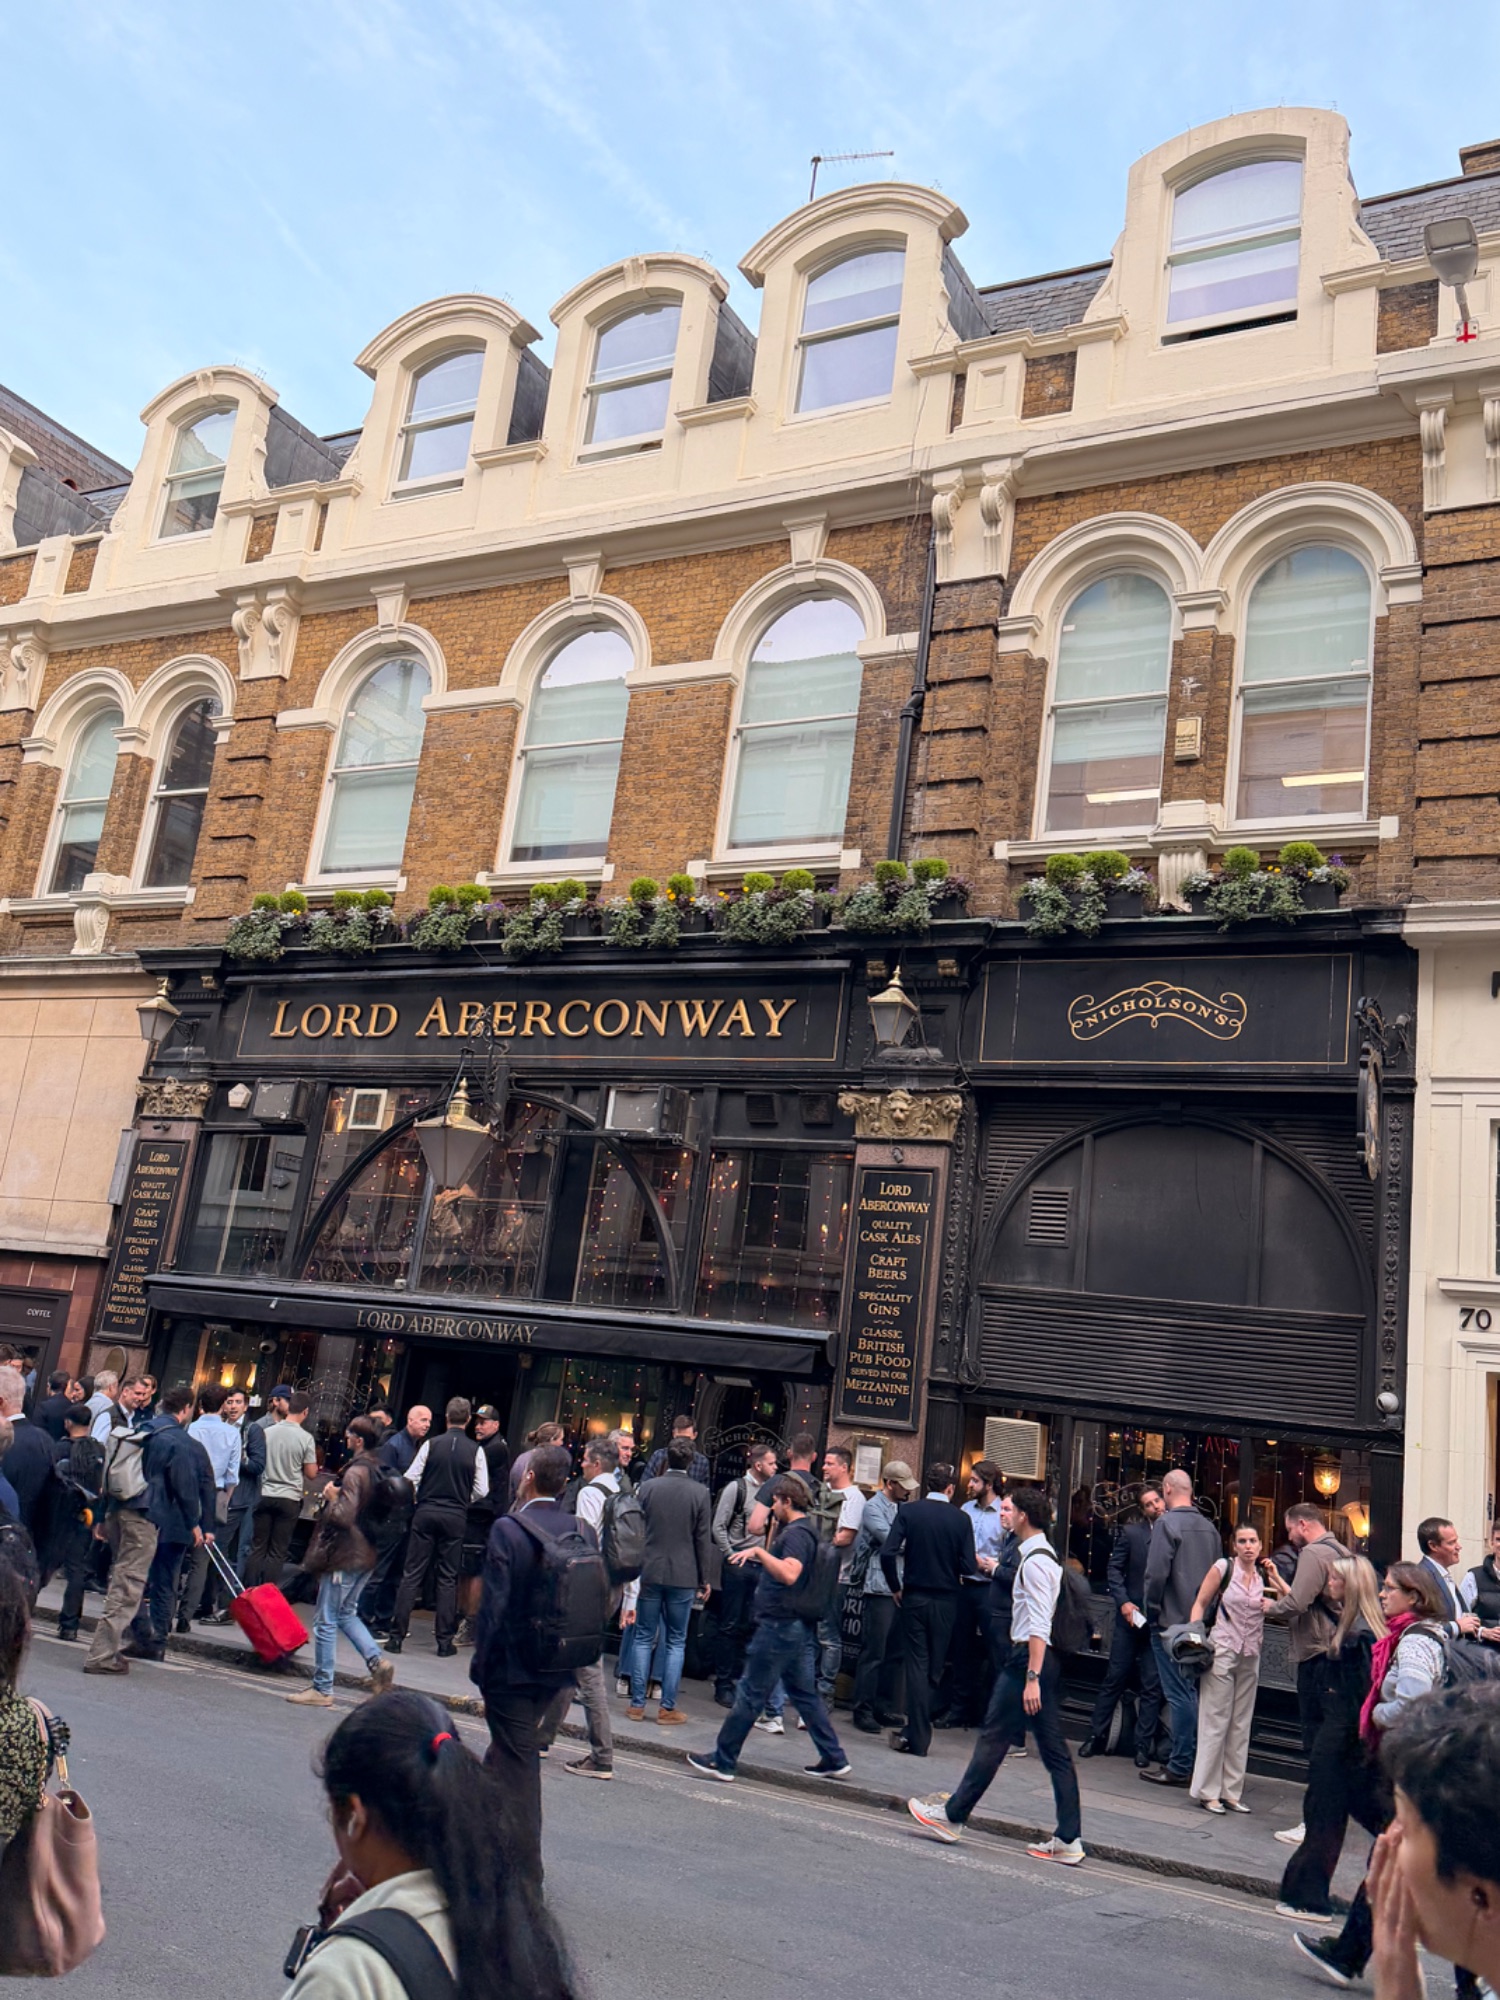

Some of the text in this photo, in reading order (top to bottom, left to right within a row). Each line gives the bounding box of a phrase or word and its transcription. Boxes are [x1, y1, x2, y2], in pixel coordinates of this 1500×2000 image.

[270, 996, 797, 1037] LORD ABERCONWAY
[1085, 997, 1229, 1027] NICHOLSON'S
[148, 1151, 170, 1162] LORD
[134, 1164, 180, 1176] ABERCONWAY
[141, 1181, 167, 1189] QUALITY
[880, 1182, 912, 1196] LORD
[132, 1190, 171, 1200] CASK ALES
[859, 1198, 931, 1213] ABERCONWAY
[135, 1208, 160, 1217] CRAFT
[132, 1218, 158, 1228] BEERS
[871, 1220, 912, 1231] QUALITY
[124, 1237, 159, 1246] SPECIALITY
[860, 1230, 922, 1245] CASK ALES
[129, 1246, 150, 1256] GINS
[870, 1254, 908, 1267] CRAFT
[122, 1264, 148, 1273] CLASSIC
[867, 1267, 907, 1280] BEERS
[118, 1272, 144, 1283] BRITIS
[112, 1283, 127, 1292] PUB
[858, 1291, 913, 1304] SPECIALITY
[867, 1303, 901, 1317] GINS
[1460, 1306, 1492, 1330] 70
[357, 1310, 538, 1343] LORD ABERCONWAY
[862, 1327, 903, 1339] CLASSIC
[857, 1337, 905, 1354] BRITISH
[849, 1351, 912, 1368] PUB FOOD
[850, 1367, 908, 1380] SERVED IN OUR
[845, 1377, 910, 1395] MEZZANINE
[856, 1394, 897, 1407] ALL DAY
